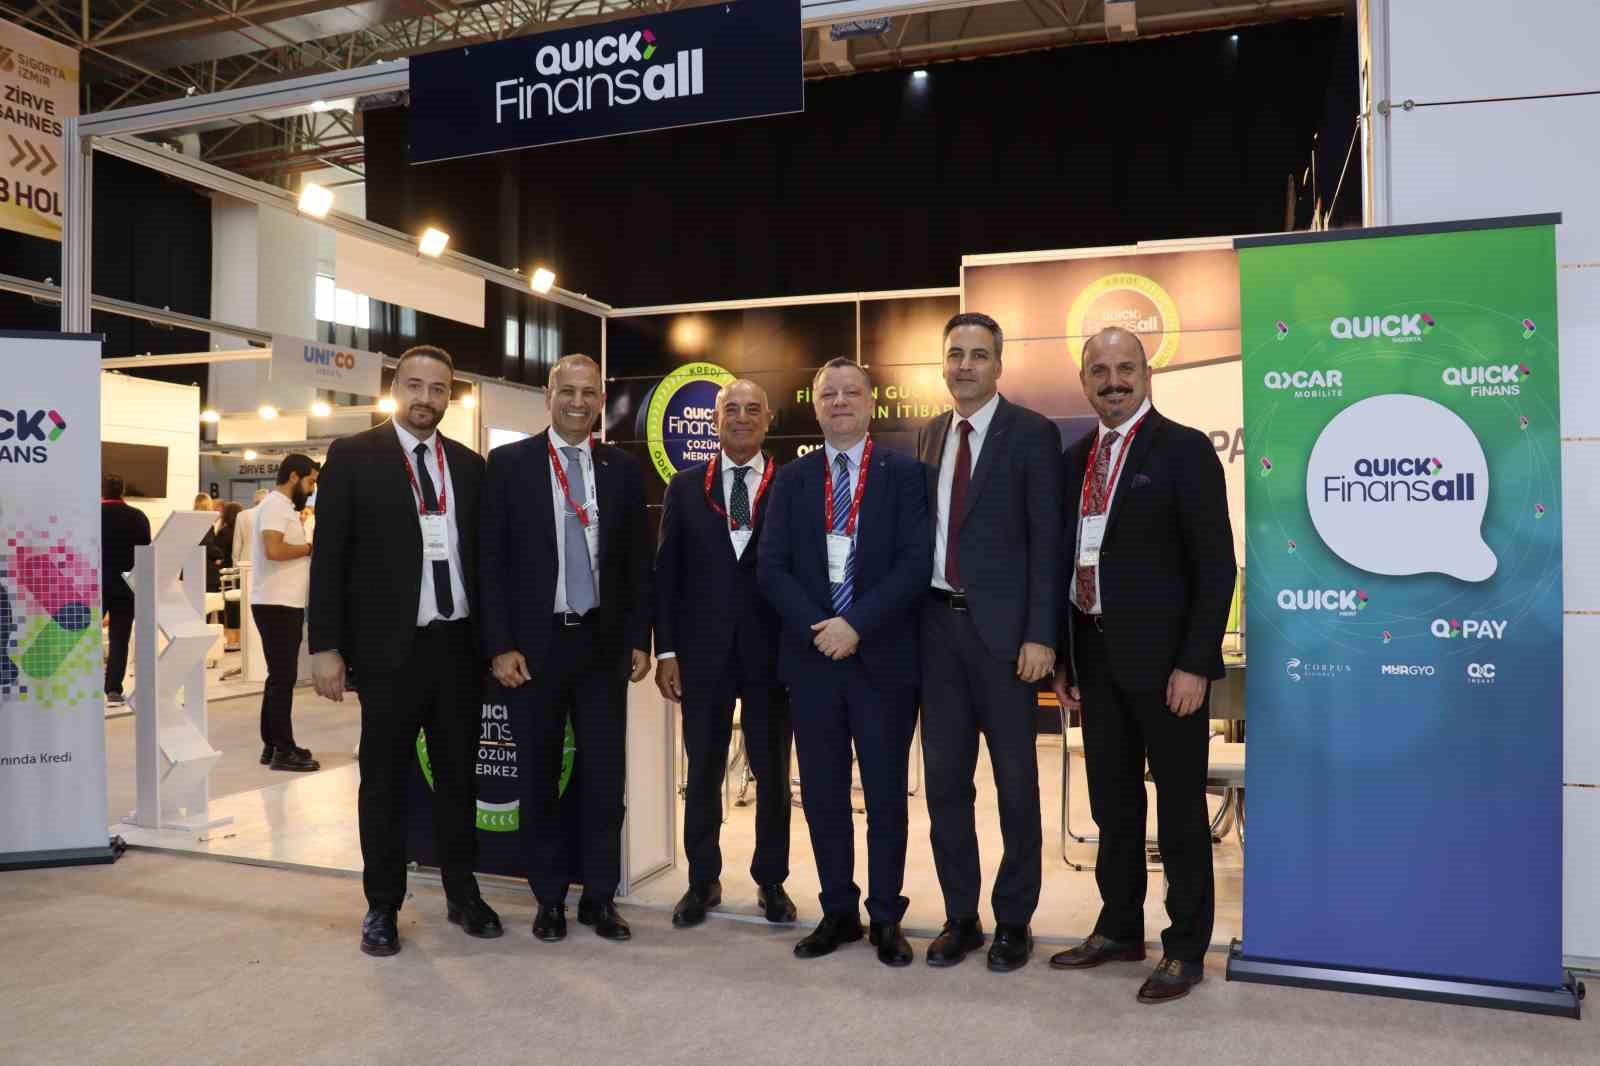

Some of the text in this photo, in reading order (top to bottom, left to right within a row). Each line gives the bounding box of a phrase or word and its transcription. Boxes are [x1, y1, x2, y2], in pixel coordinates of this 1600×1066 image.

[535, 30, 642, 76] QUICK
[495, 48, 703, 124] Finansall
[4, 84, 56, 116] ZİRVE
[1330, 313, 1422, 340] QUICK
[1442, 364, 1519, 386] QUICK
[1354, 458, 1431, 478] QUICK
[1323, 473, 1475, 503] Finansall
[1277, 588, 1357, 611] QUICK
[40, 751, 72, 764] Kredi
